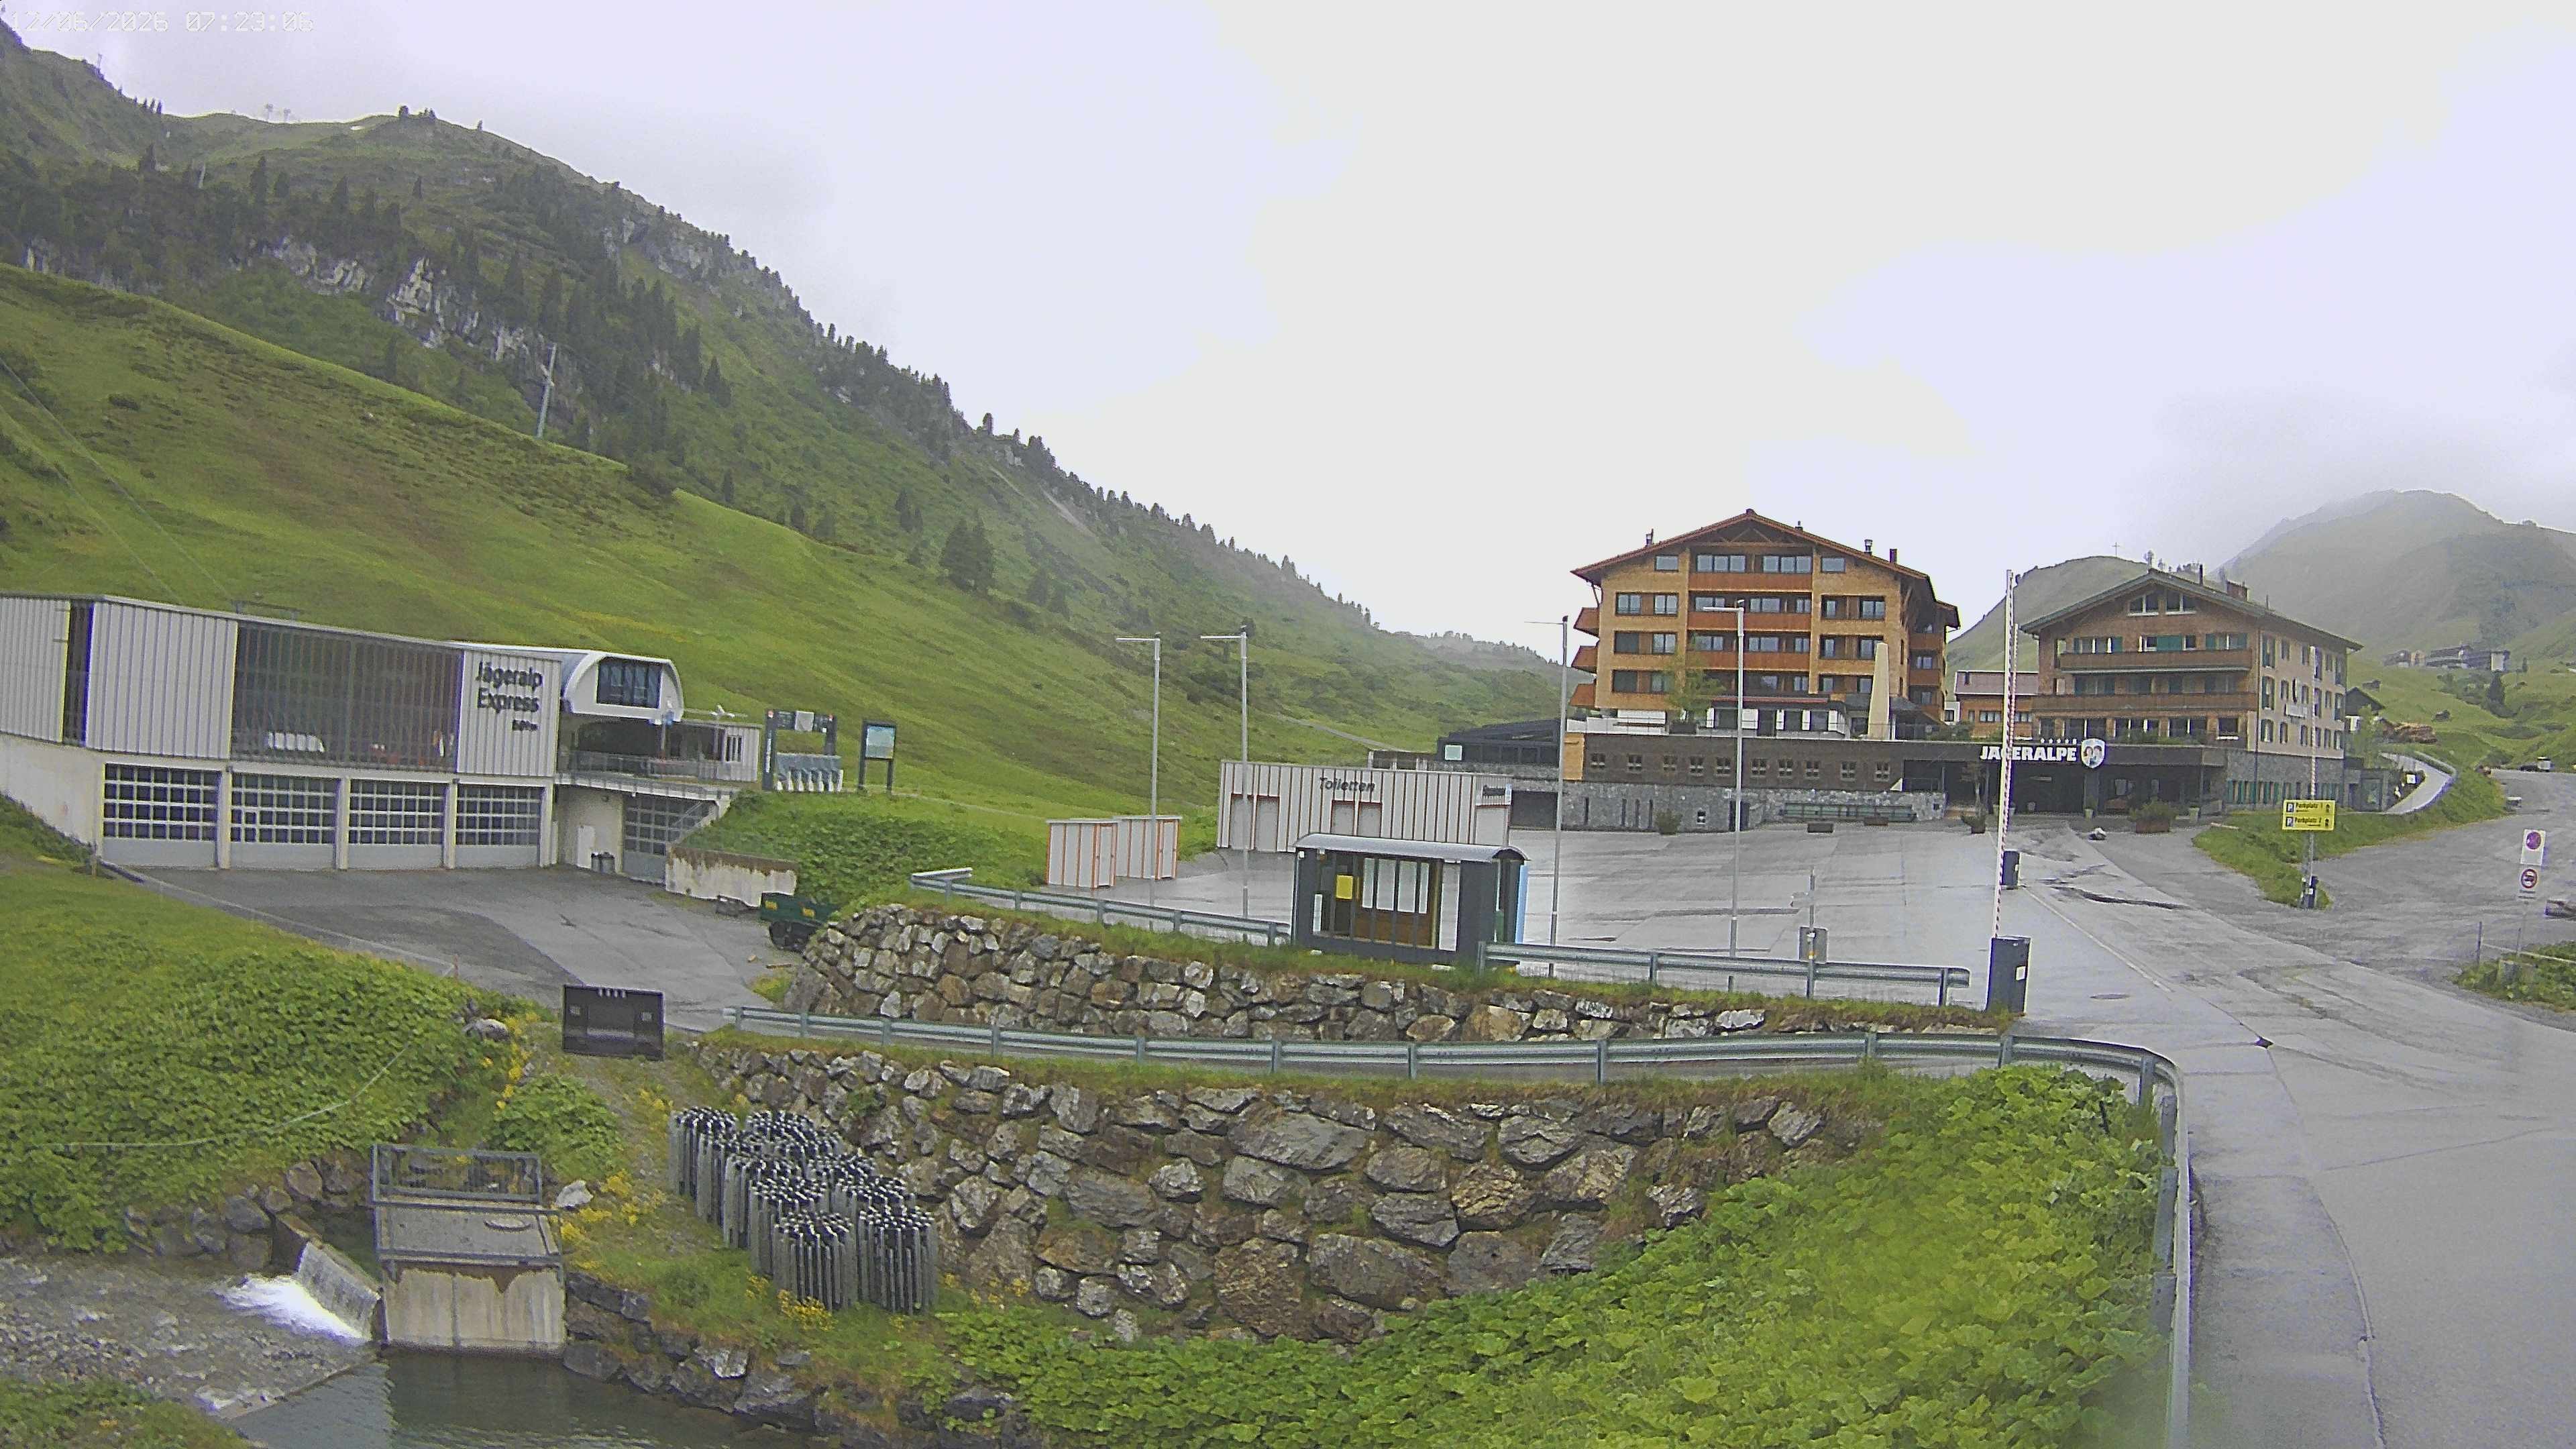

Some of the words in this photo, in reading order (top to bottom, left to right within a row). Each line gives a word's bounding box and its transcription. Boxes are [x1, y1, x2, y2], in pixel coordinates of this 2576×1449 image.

[476, 661, 543, 691] Jägeralp
[477, 687, 540, 713] Express
[1320, 777, 1375, 792] Toiletten
